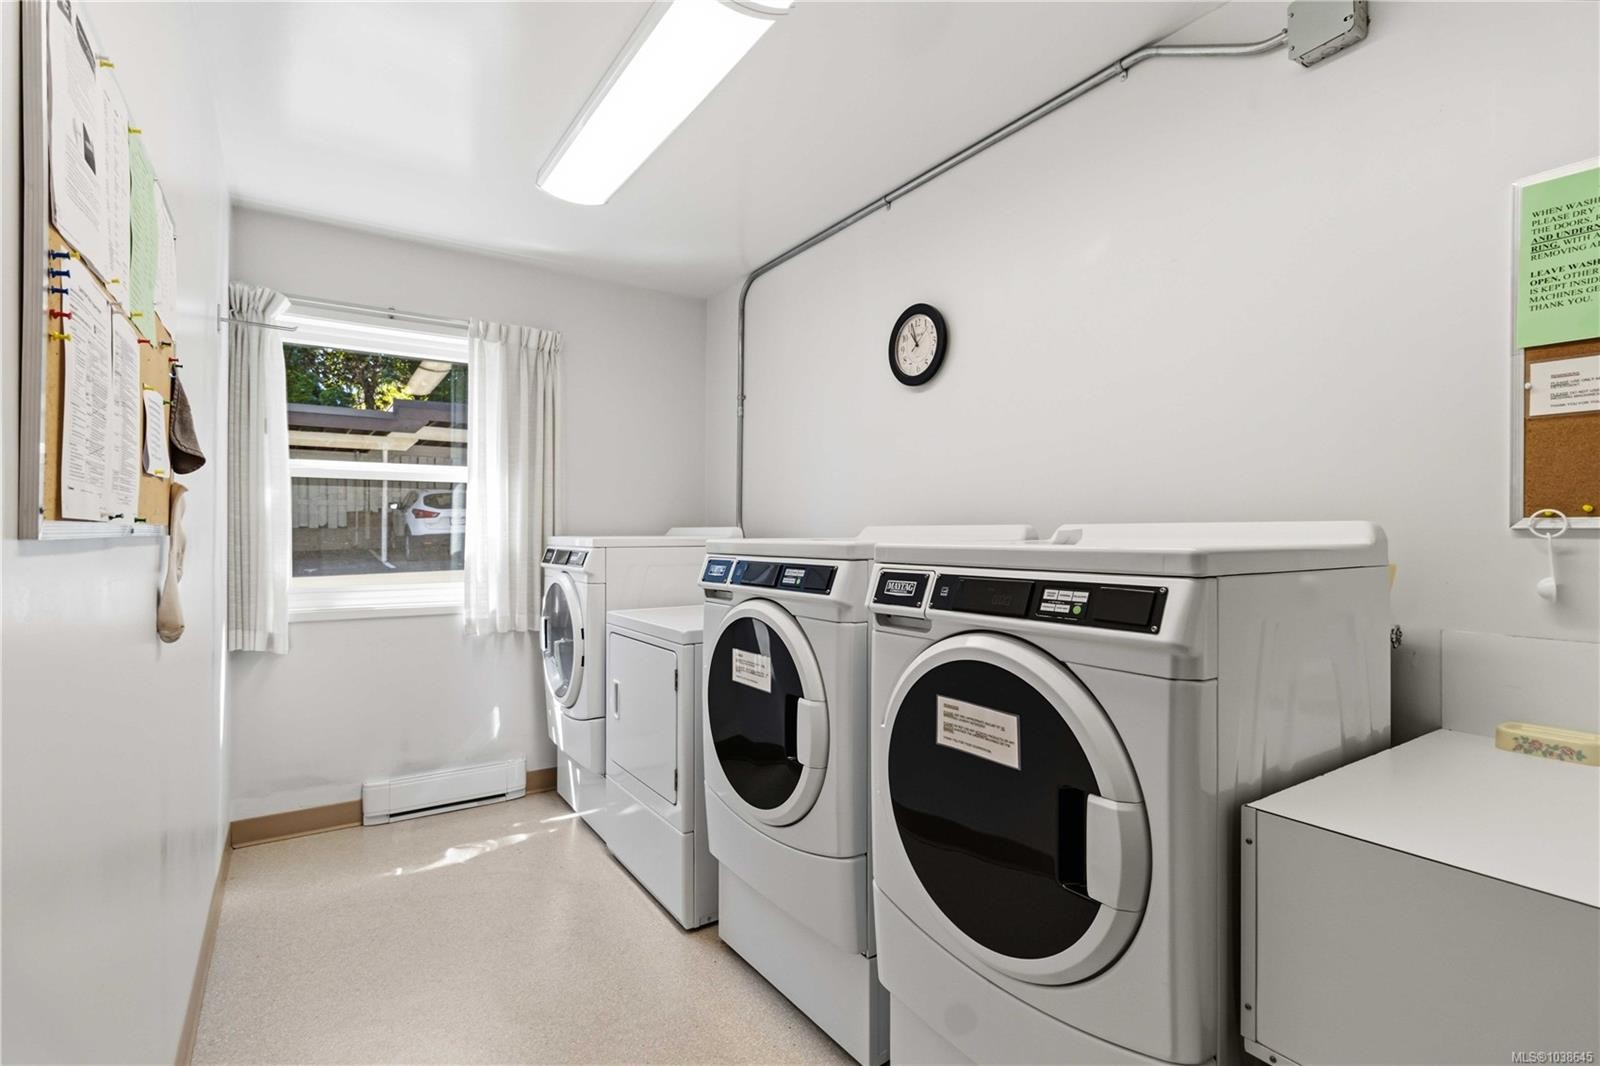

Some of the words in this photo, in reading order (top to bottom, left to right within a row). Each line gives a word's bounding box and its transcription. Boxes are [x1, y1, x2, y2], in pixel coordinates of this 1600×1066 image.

[1532, 206, 1563, 218] WHEN
[1532, 213, 1569, 227] PLEASE
[1573, 207, 1594, 218] DRY
[1533, 225, 1550, 235] THE
[1532, 233, 1554, 245] AND
[1564, 233, 1590, 245] WITH
[1531, 245, 1587, 261] REMOVING
[1531, 265, 1566, 278] LEAVE
[1541, 282, 1567, 293] KEPT
[1530, 288, 1583, 303] MACHINES
[1530, 300, 1565, 312] THANK
[887, 581, 915, 592] MAYTAG
